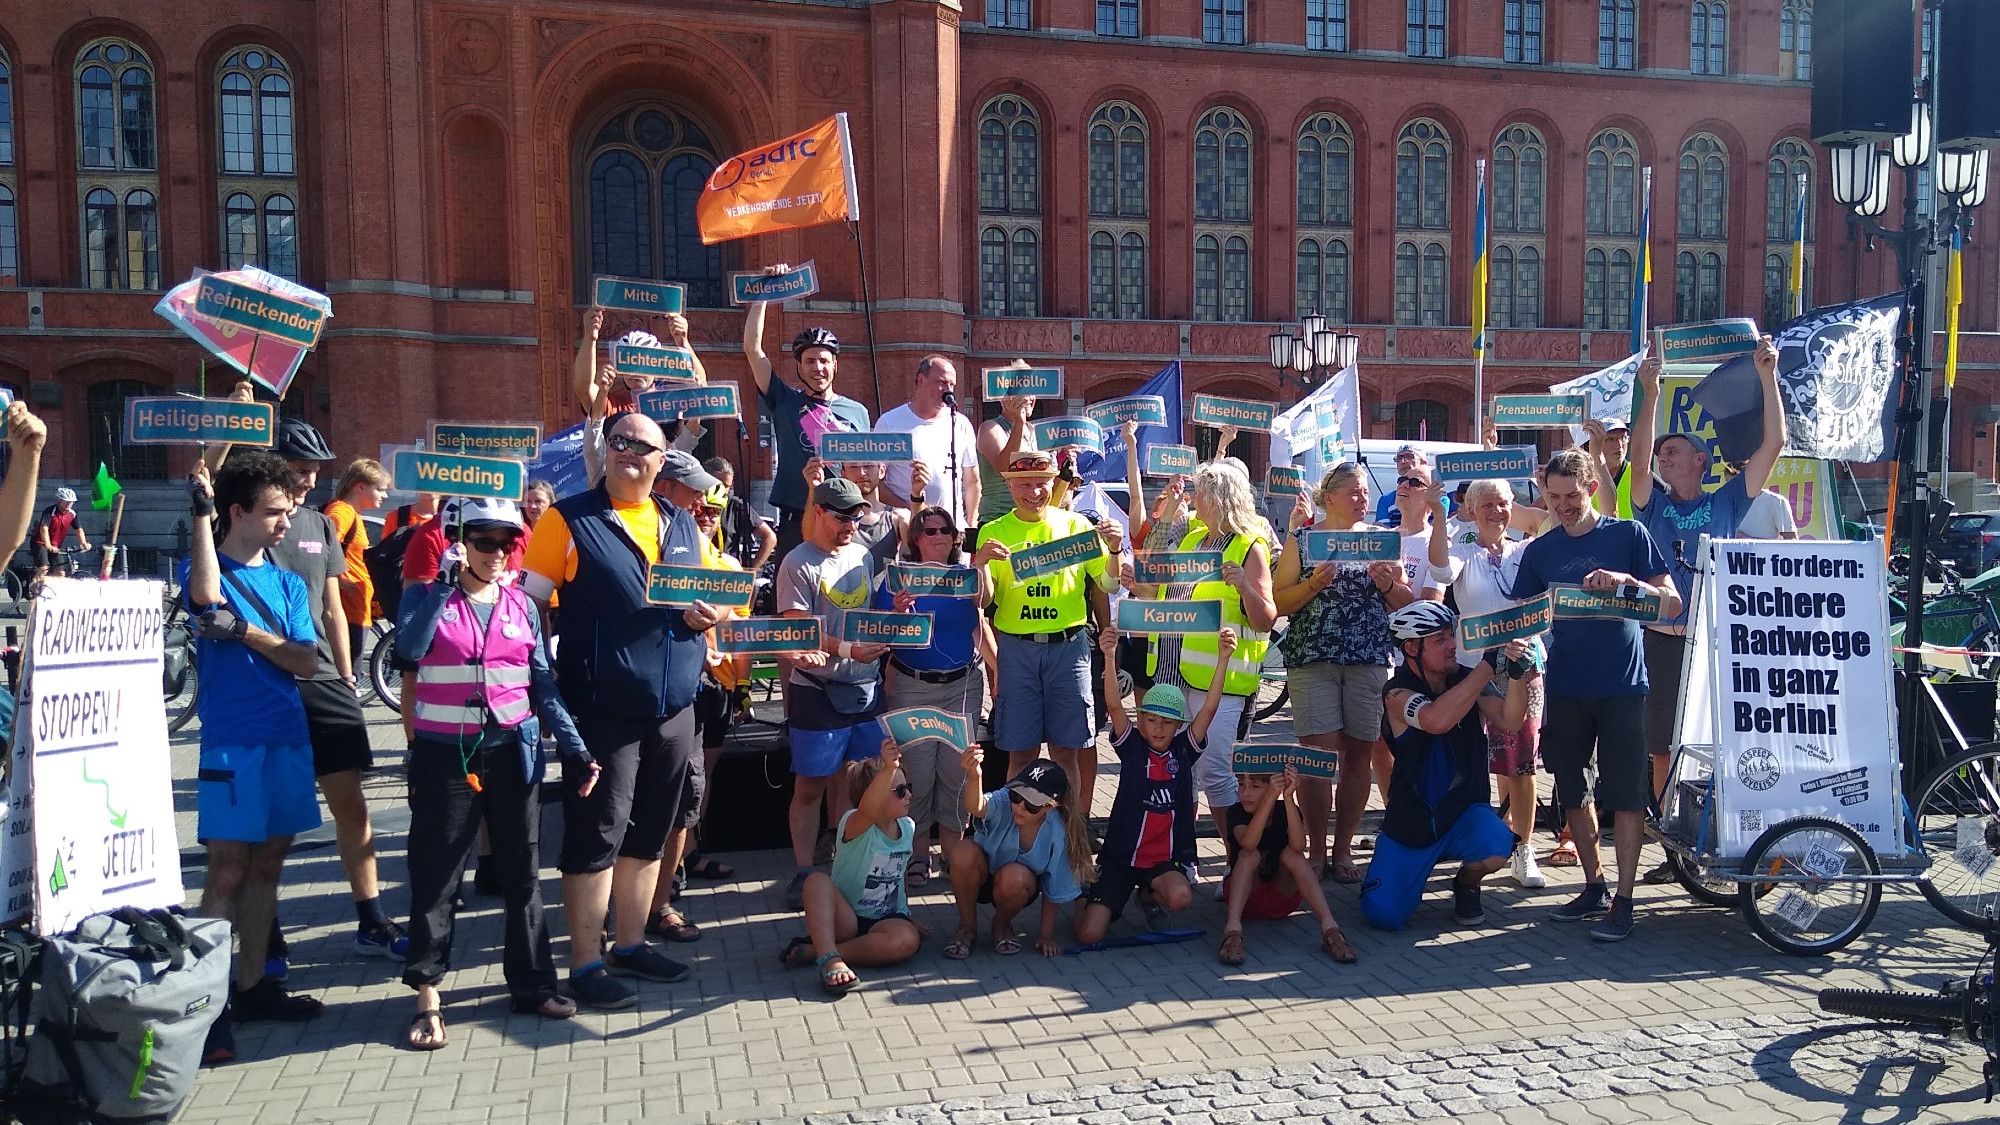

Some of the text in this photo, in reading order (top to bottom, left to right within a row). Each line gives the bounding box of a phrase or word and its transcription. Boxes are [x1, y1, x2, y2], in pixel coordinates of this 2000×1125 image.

[749, 138, 817, 167] adfc
[725, 197, 792, 217] VERKEHRSWENDE
[744, 277, 804, 295] Adlershof
[623, 289, 658, 303] Mitte
[200, 286, 322, 333] Reinickendorf
[1664, 331, 1755, 350] Gesundbrunnen
[618, 352, 694, 371] Lichterfelde
[996, 375, 1047, 390] Neukölln
[648, 395, 728, 413] Tiergarten
[1200, 403, 1267, 421] Haselhorst
[1496, 405, 1554, 415] Prenzlauer
[1557, 404, 1582, 417] Berg
[138, 409, 266, 431] Heiligensee
[1115, 412, 1138, 422] Nord
[436, 433, 535, 448] Siemensstadt
[828, 439, 907, 452] Haselhorst
[1440, 456, 1530, 473] Heinersdorf
[417, 462, 504, 490] Wedding
[1015, 537, 1099, 572] Johannisthal
[1327, 538, 1381, 554] Steglitz
[1141, 559, 1215, 576] Tempelhof
[1726, 552, 1864, 578] Wir fordern:
[650, 573, 753, 594] Friedrichsfelde
[900, 573, 963, 588] Westend
[1027, 582, 1051, 598] ein
[1559, 596, 1656, 613] Friedrichshain
[1727, 584, 1845, 618] Sichere
[1020, 605, 1058, 620] Auto
[1144, 608, 1197, 622] Karow
[40, 607, 161, 655] RADWEGESTOPP
[857, 619, 922, 636] Halensee
[1464, 607, 1549, 640] Lichtenberg
[721, 626, 815, 642] Hellersdorf
[1730, 623, 1871, 660] Radwege
[1732, 662, 1840, 697] in ganz
[1734, 701, 1837, 735] Berlin!
[1234, 752, 1335, 772] Charlottenburg
[1739, 749, 1771, 766] RESPECT
[1743, 769, 1780, 791] CYCLISTS
